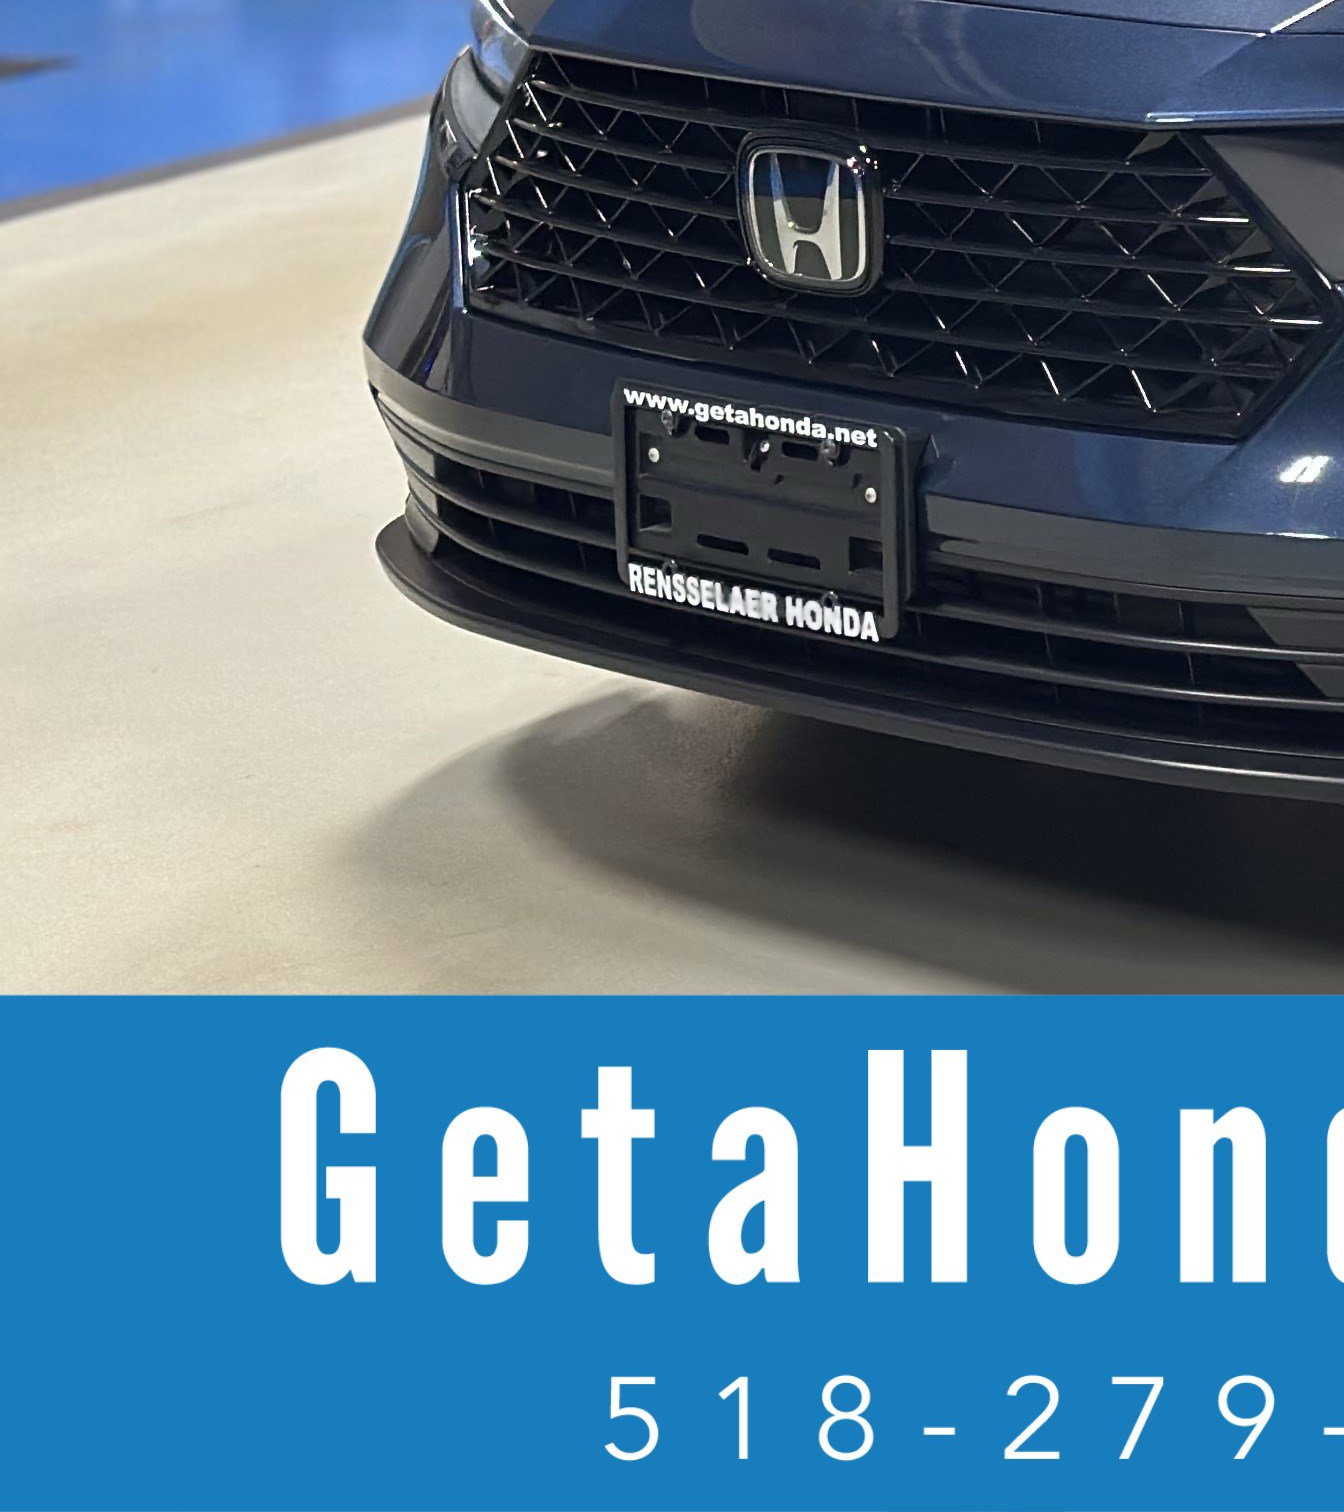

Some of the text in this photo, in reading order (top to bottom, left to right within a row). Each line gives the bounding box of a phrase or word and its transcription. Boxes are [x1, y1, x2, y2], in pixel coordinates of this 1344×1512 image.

[623, 388, 878, 448] www.getahonda.net
[628, 561, 880, 643] RENSSELAER HONDA
